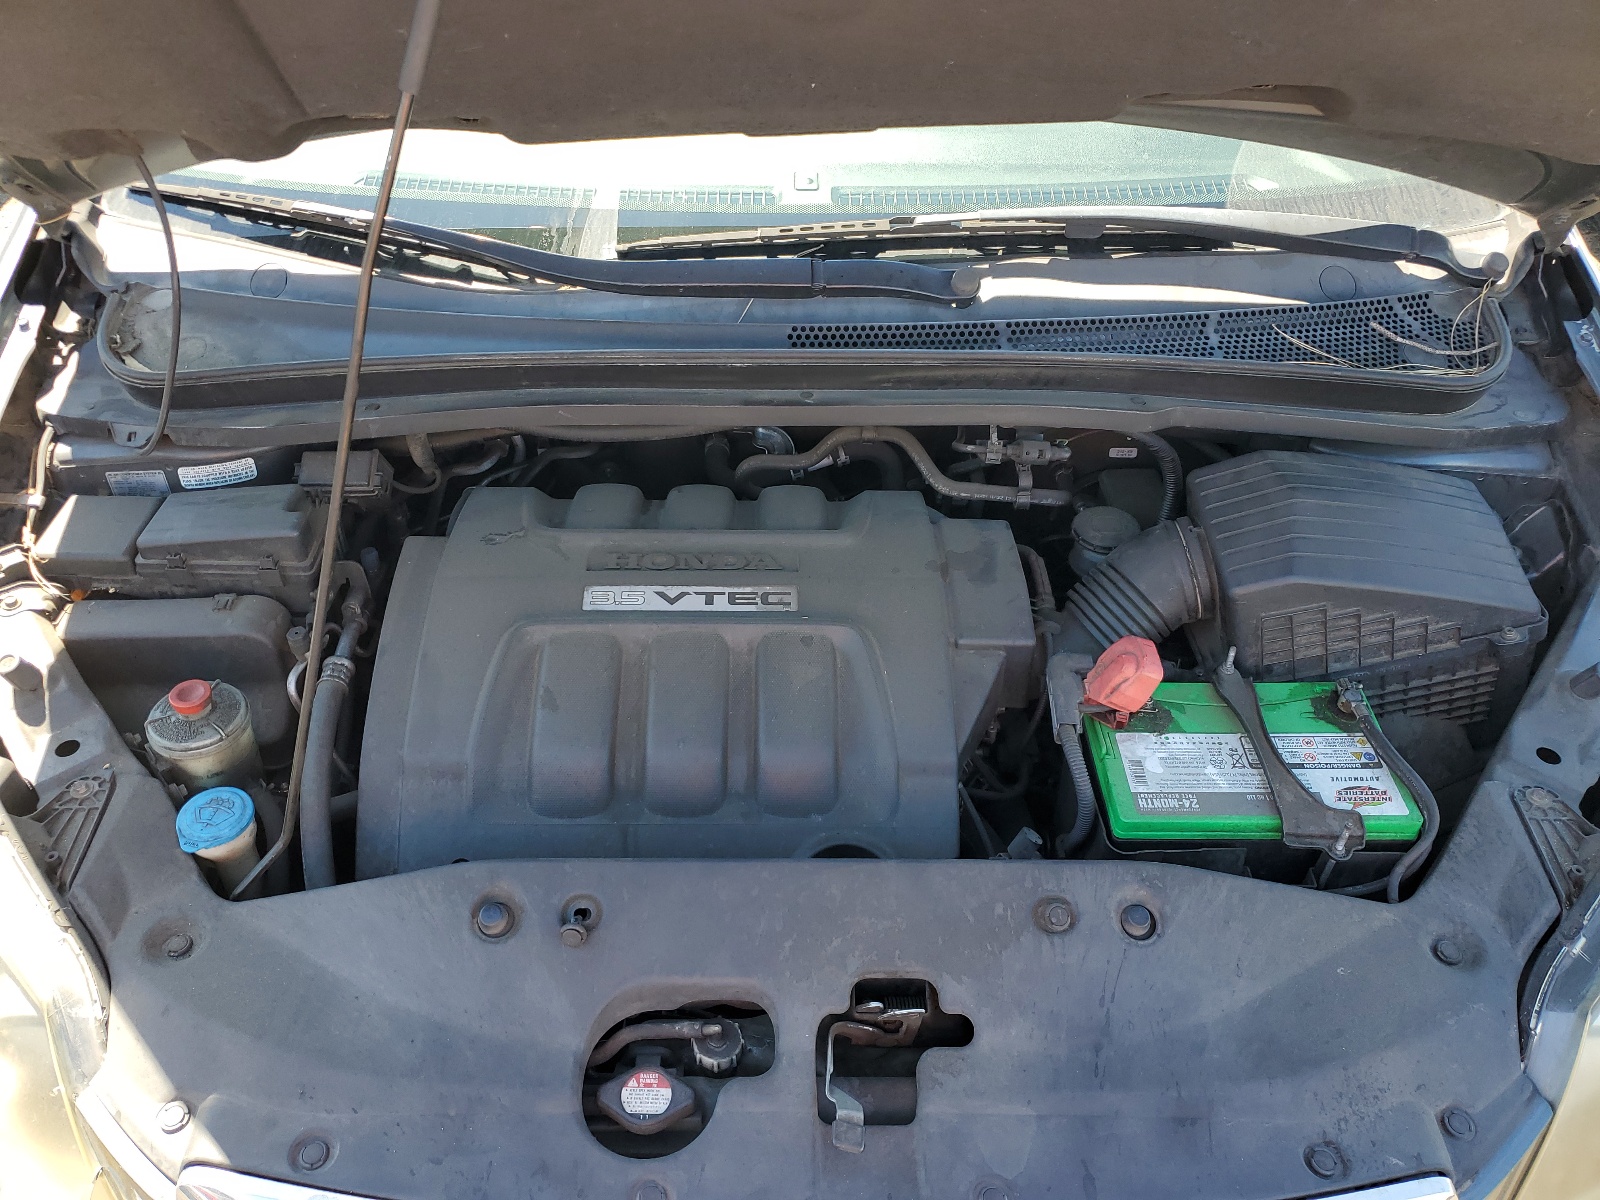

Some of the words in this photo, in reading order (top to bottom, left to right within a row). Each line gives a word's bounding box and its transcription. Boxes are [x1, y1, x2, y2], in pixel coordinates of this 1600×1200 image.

[604, 551, 784, 571] HONDA
[589, 590, 646, 606] 3.5
[652, 590, 792, 606] VTEC
[1138, 798, 1200, 808] 24-MONTH
